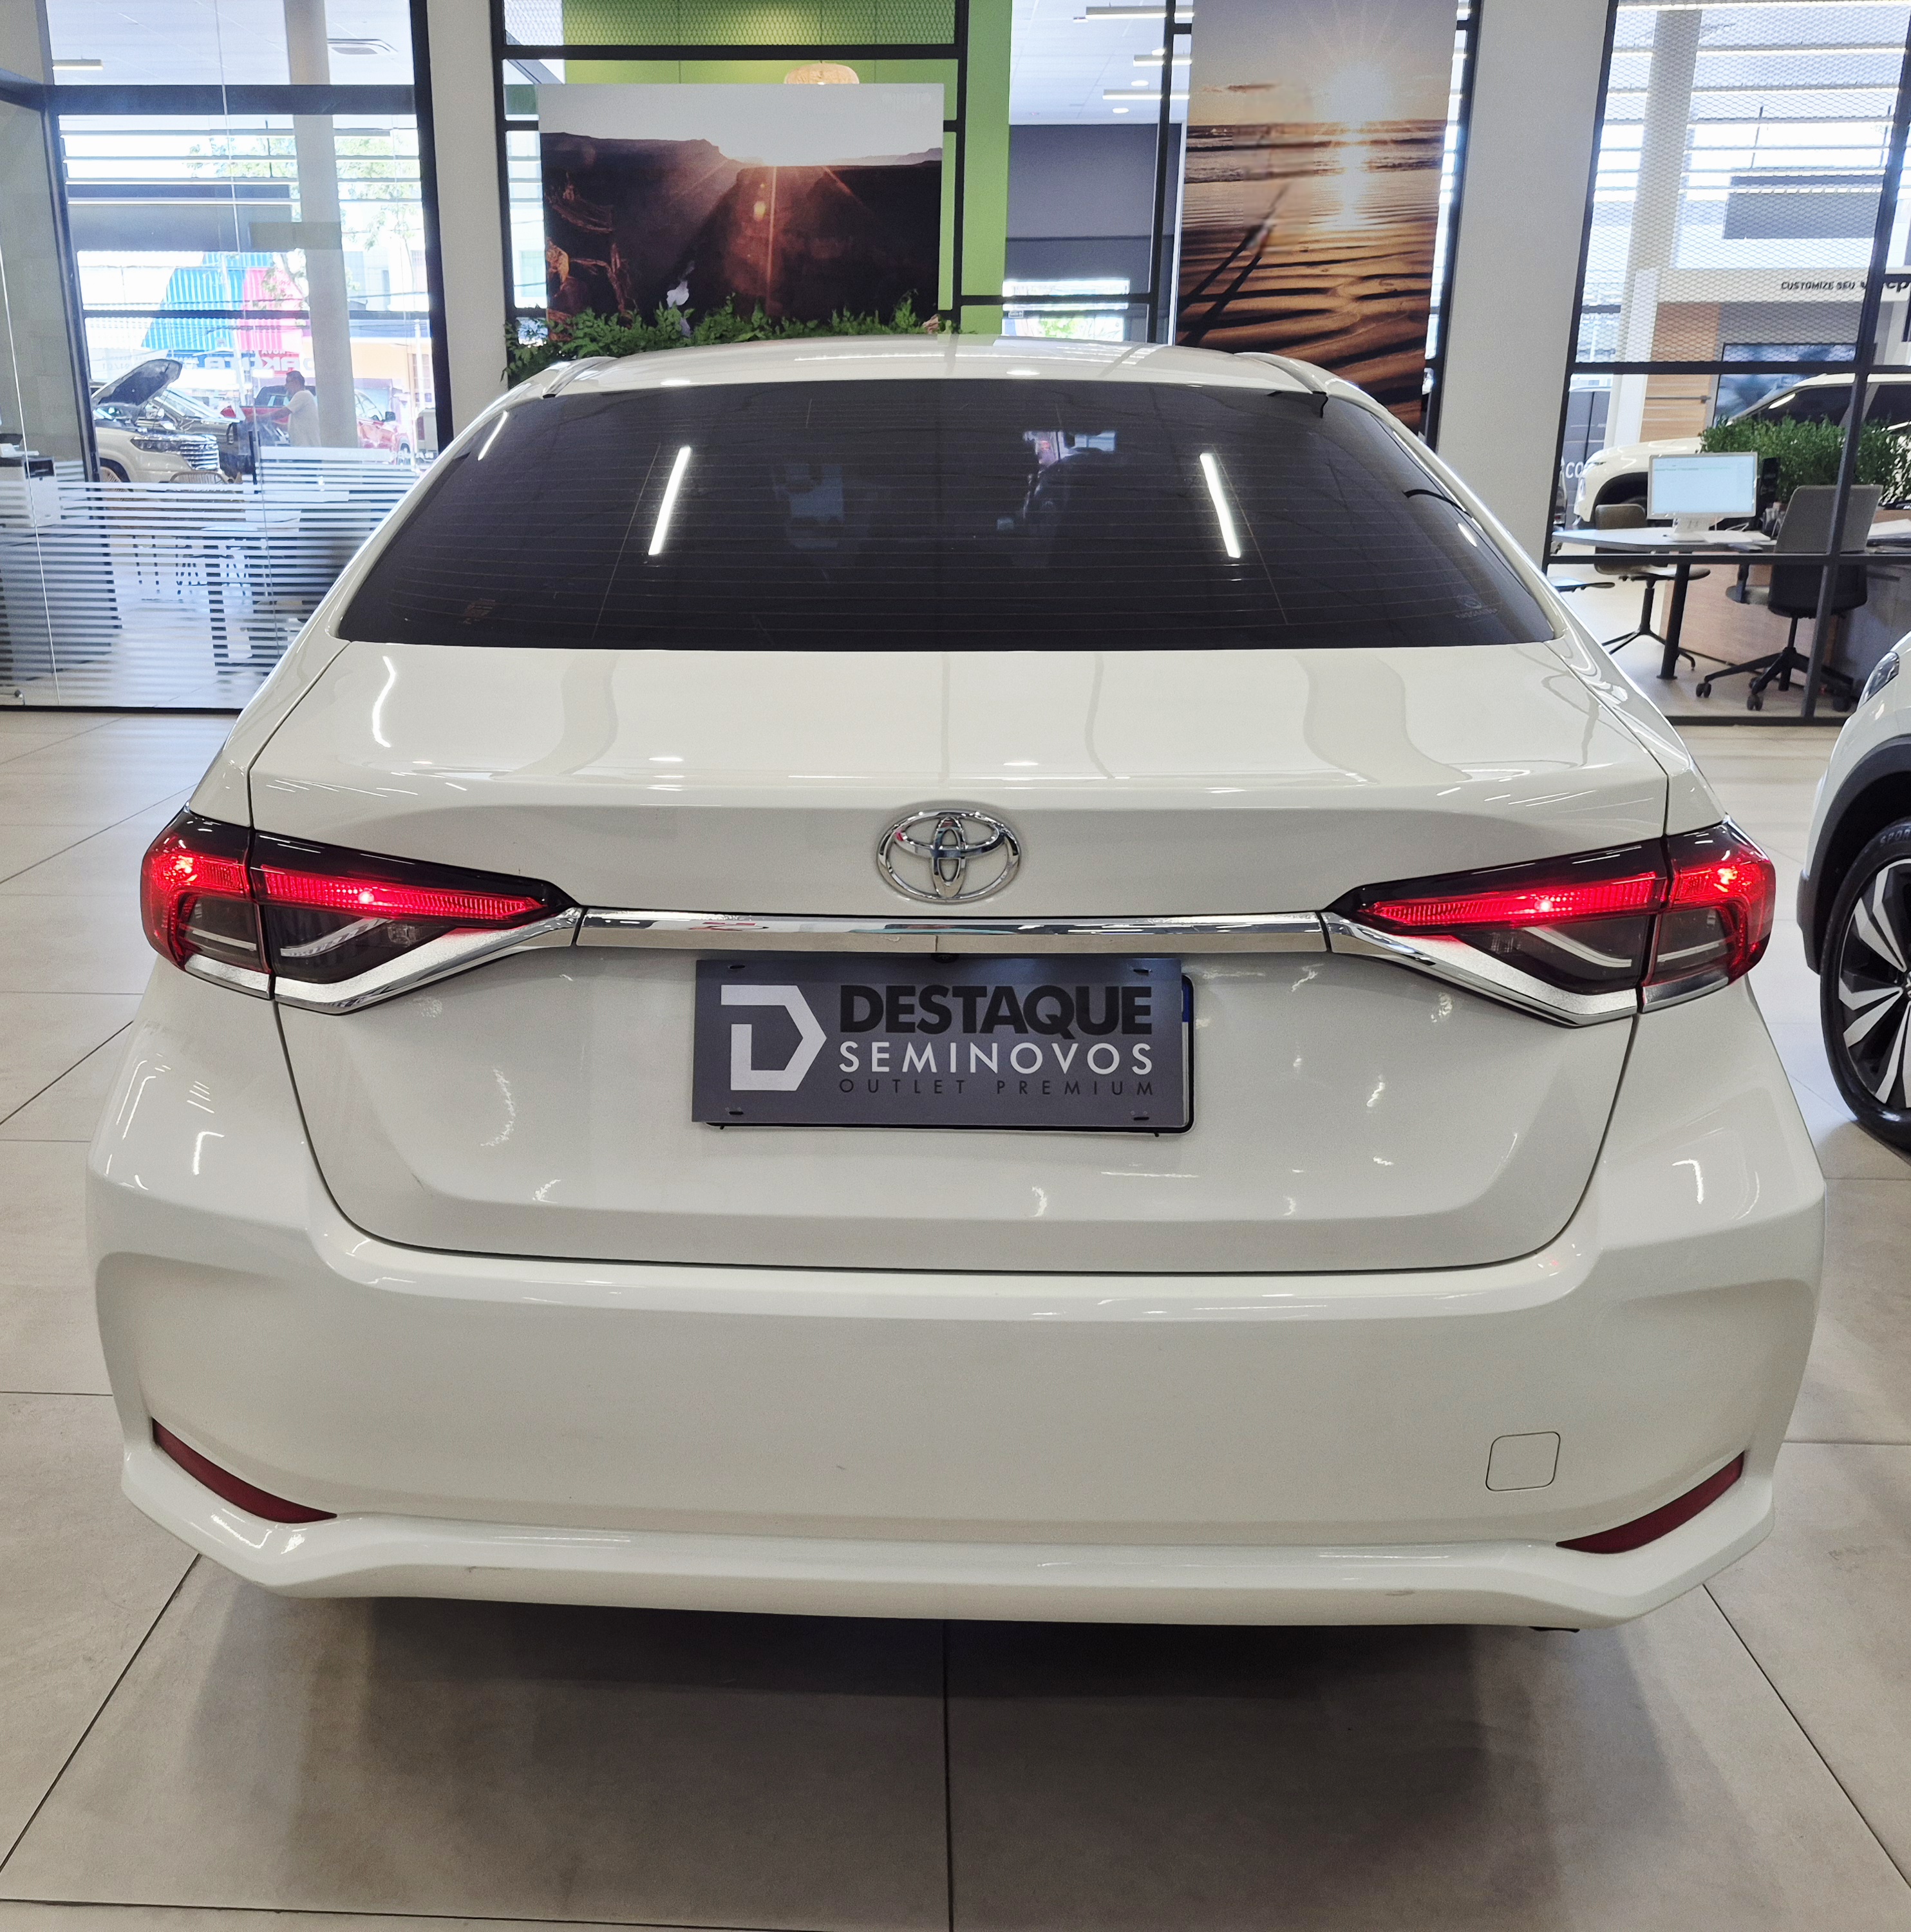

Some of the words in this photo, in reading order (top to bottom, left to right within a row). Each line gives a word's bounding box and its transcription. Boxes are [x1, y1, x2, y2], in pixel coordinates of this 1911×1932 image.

[1781, 281, 1834, 290] CUSTOMIZE
[840, 984, 1153, 1039] DESTAQUE
[839, 1041, 1153, 1075] SEMINOVOS
[839, 1079, 965, 1094] OUTLET
[997, 1080, 1153, 1095] PREMIUM
